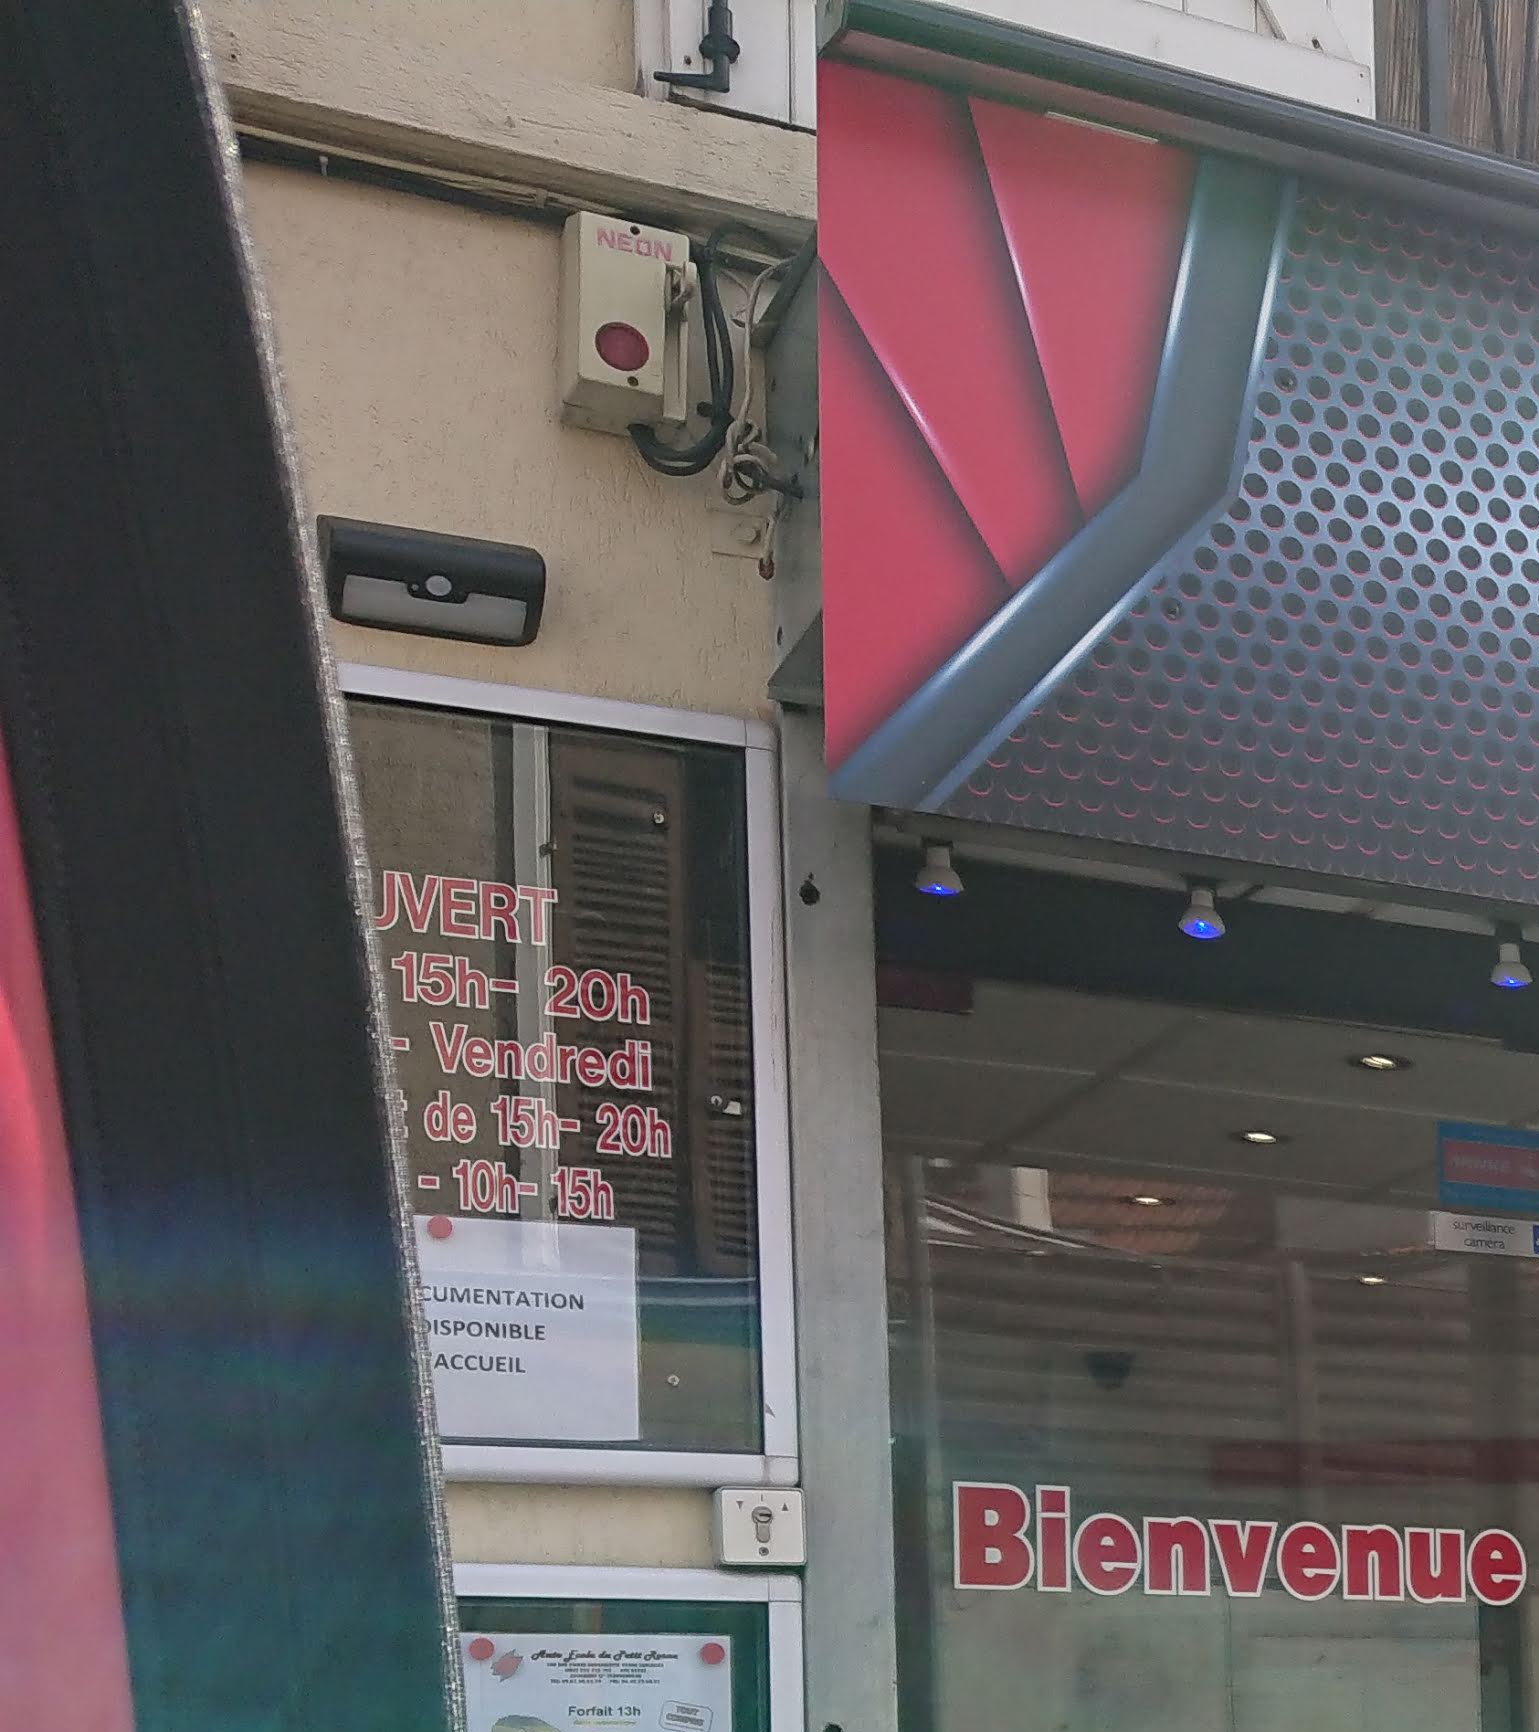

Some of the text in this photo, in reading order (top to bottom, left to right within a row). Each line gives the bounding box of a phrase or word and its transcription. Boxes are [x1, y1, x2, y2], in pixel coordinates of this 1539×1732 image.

[596, 227, 673, 262] NEON
[544, 965, 651, 1025] 20h
[429, 1021, 652, 1091] Vendredi
[424, 1090, 476, 1143] de
[596, 1102, 672, 1158] 20h
[550, 1166, 615, 1220] 15h
[1453, 1220, 1516, 1235] surveillance
[952, 1480, 1527, 1606] Bienvenue
[568, 1705, 641, 1717] Forfait 13h
